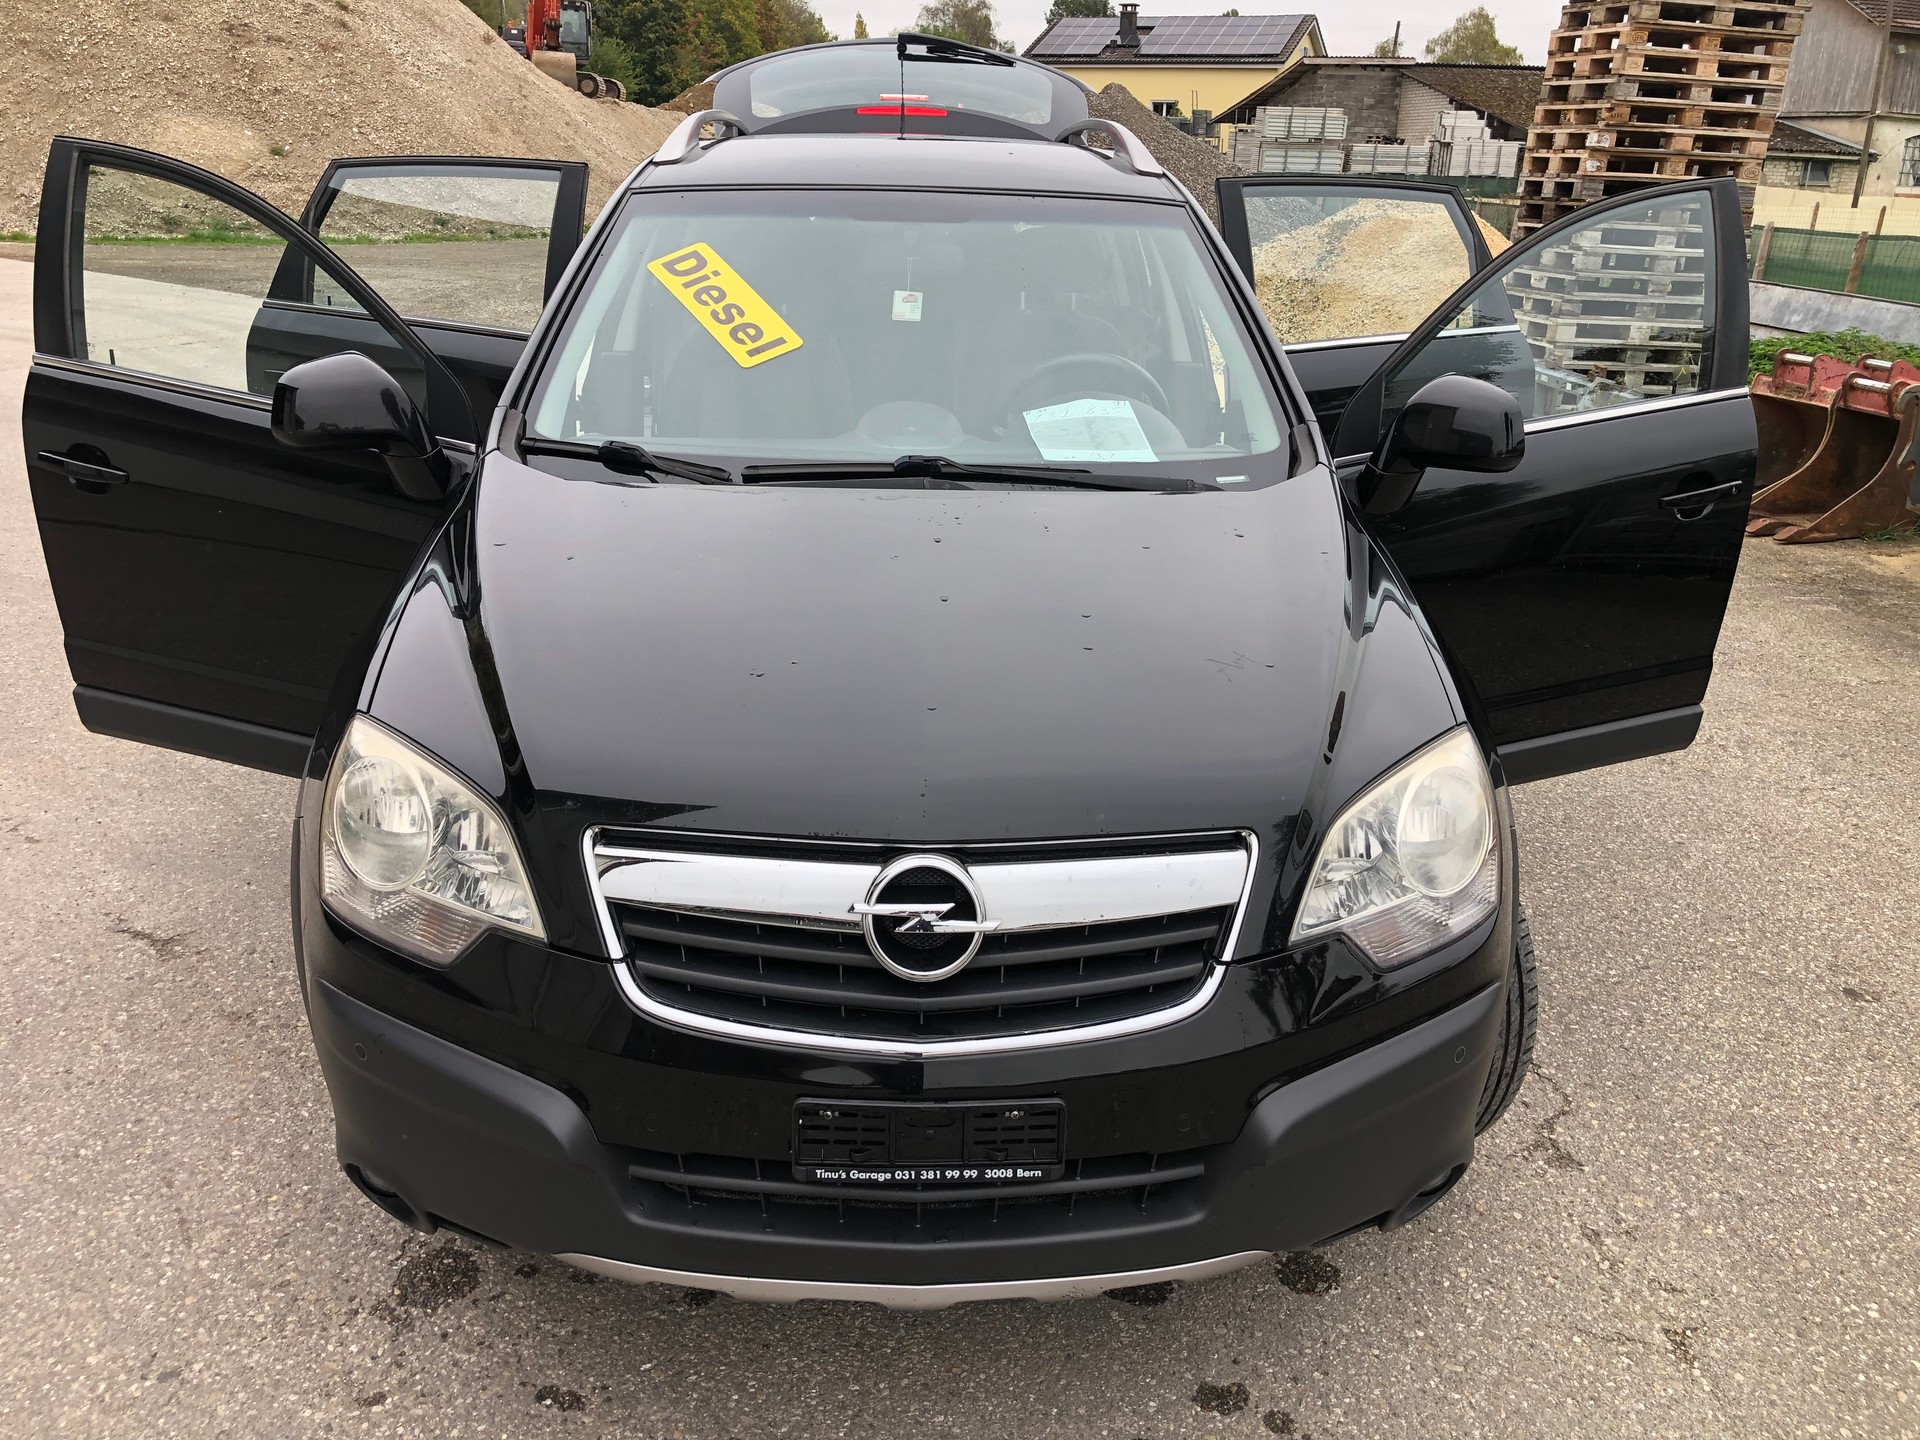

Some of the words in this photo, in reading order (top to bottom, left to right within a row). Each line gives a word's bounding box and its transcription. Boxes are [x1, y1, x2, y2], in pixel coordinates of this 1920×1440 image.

[660, 249, 788, 358] Diesel
[815, 1169, 847, 1179] Tinu's
[849, 1169, 892, 1182] Garage
[894, 1170, 917, 1180] 031
[919, 1169, 942, 1180] 381
[944, 1169, 961, 1180] 99
[962, 1169, 979, 1180] 99
[984, 1168, 1014, 1179] 3008
[1016, 1168, 1042, 1178] Bern
